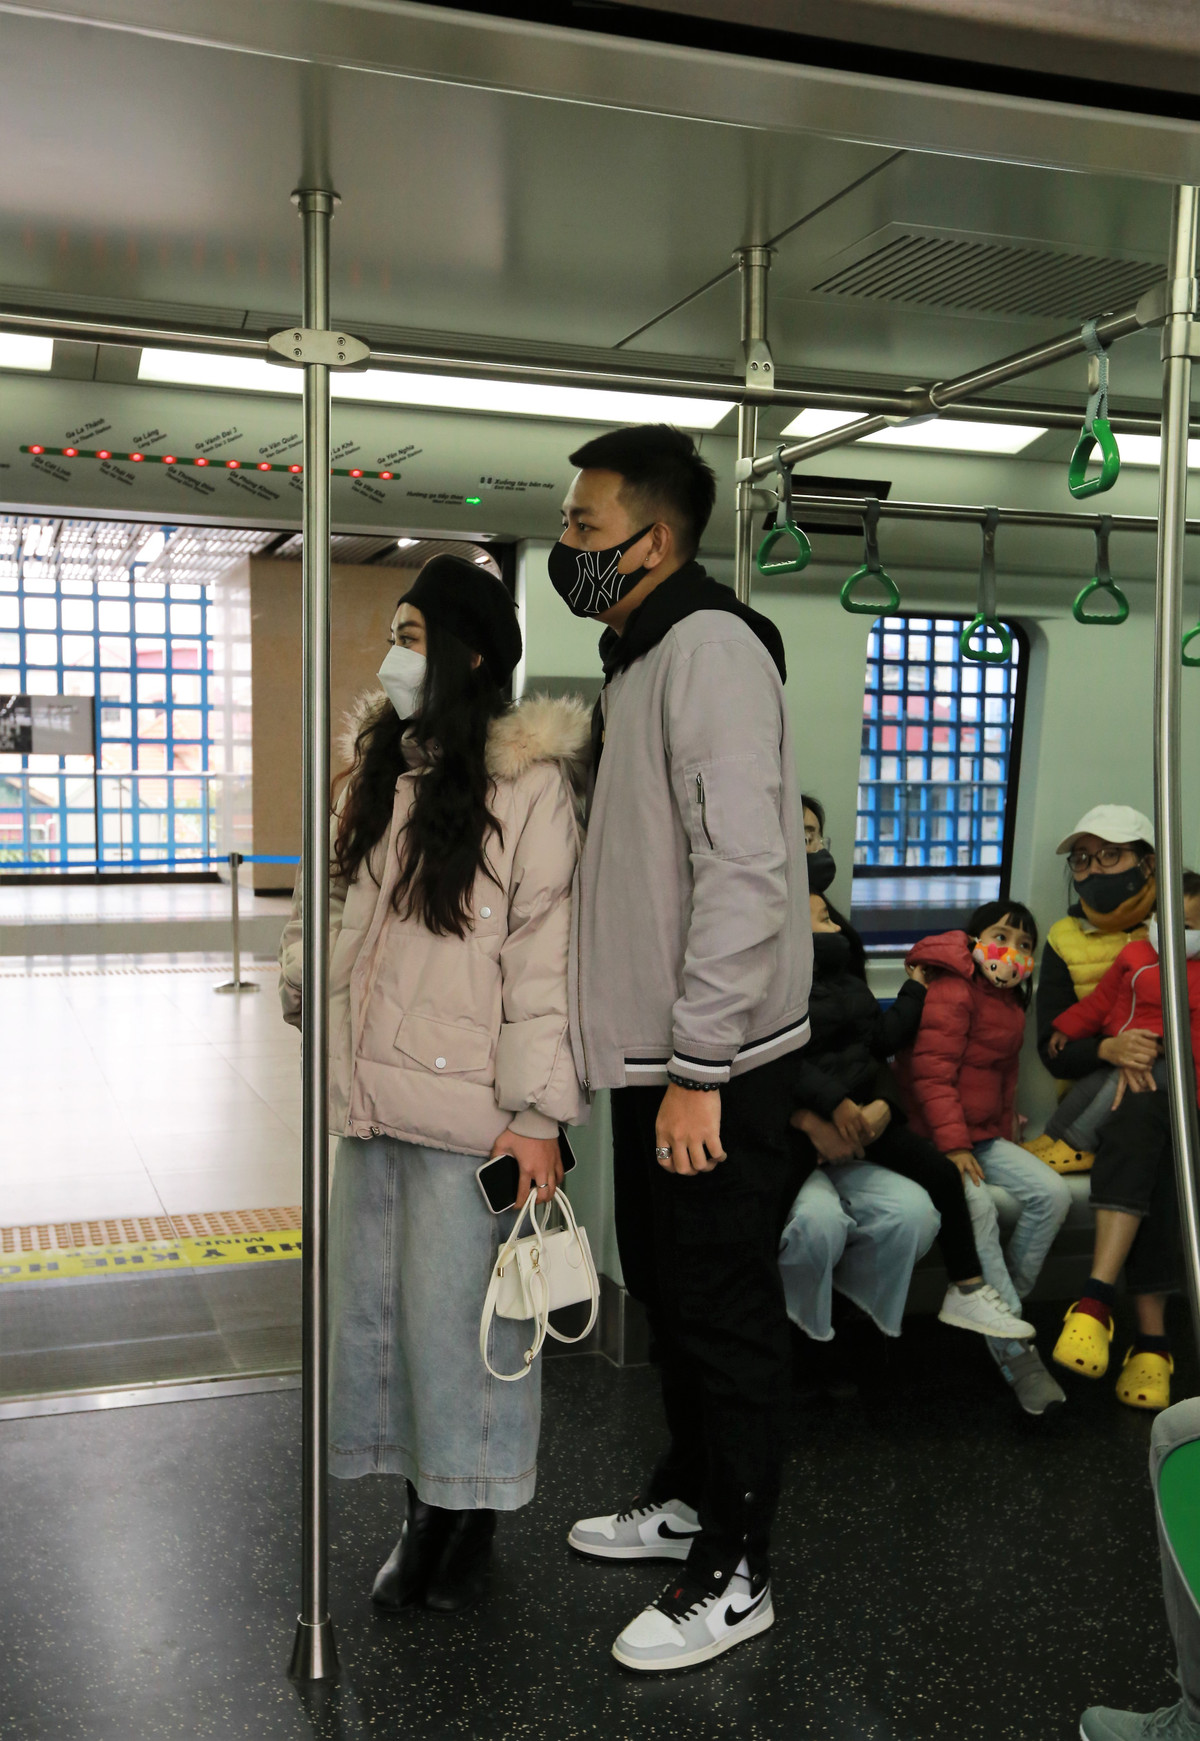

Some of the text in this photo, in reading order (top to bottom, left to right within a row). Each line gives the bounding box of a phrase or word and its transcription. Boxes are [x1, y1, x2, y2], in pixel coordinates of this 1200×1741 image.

[65, 431, 75, 439] Ga
[75, 427, 85, 435] La
[195, 442, 204, 450] Ga
[195, 1236, 264, 1247] MIND
[82, 1252, 180, 1269] KHE
